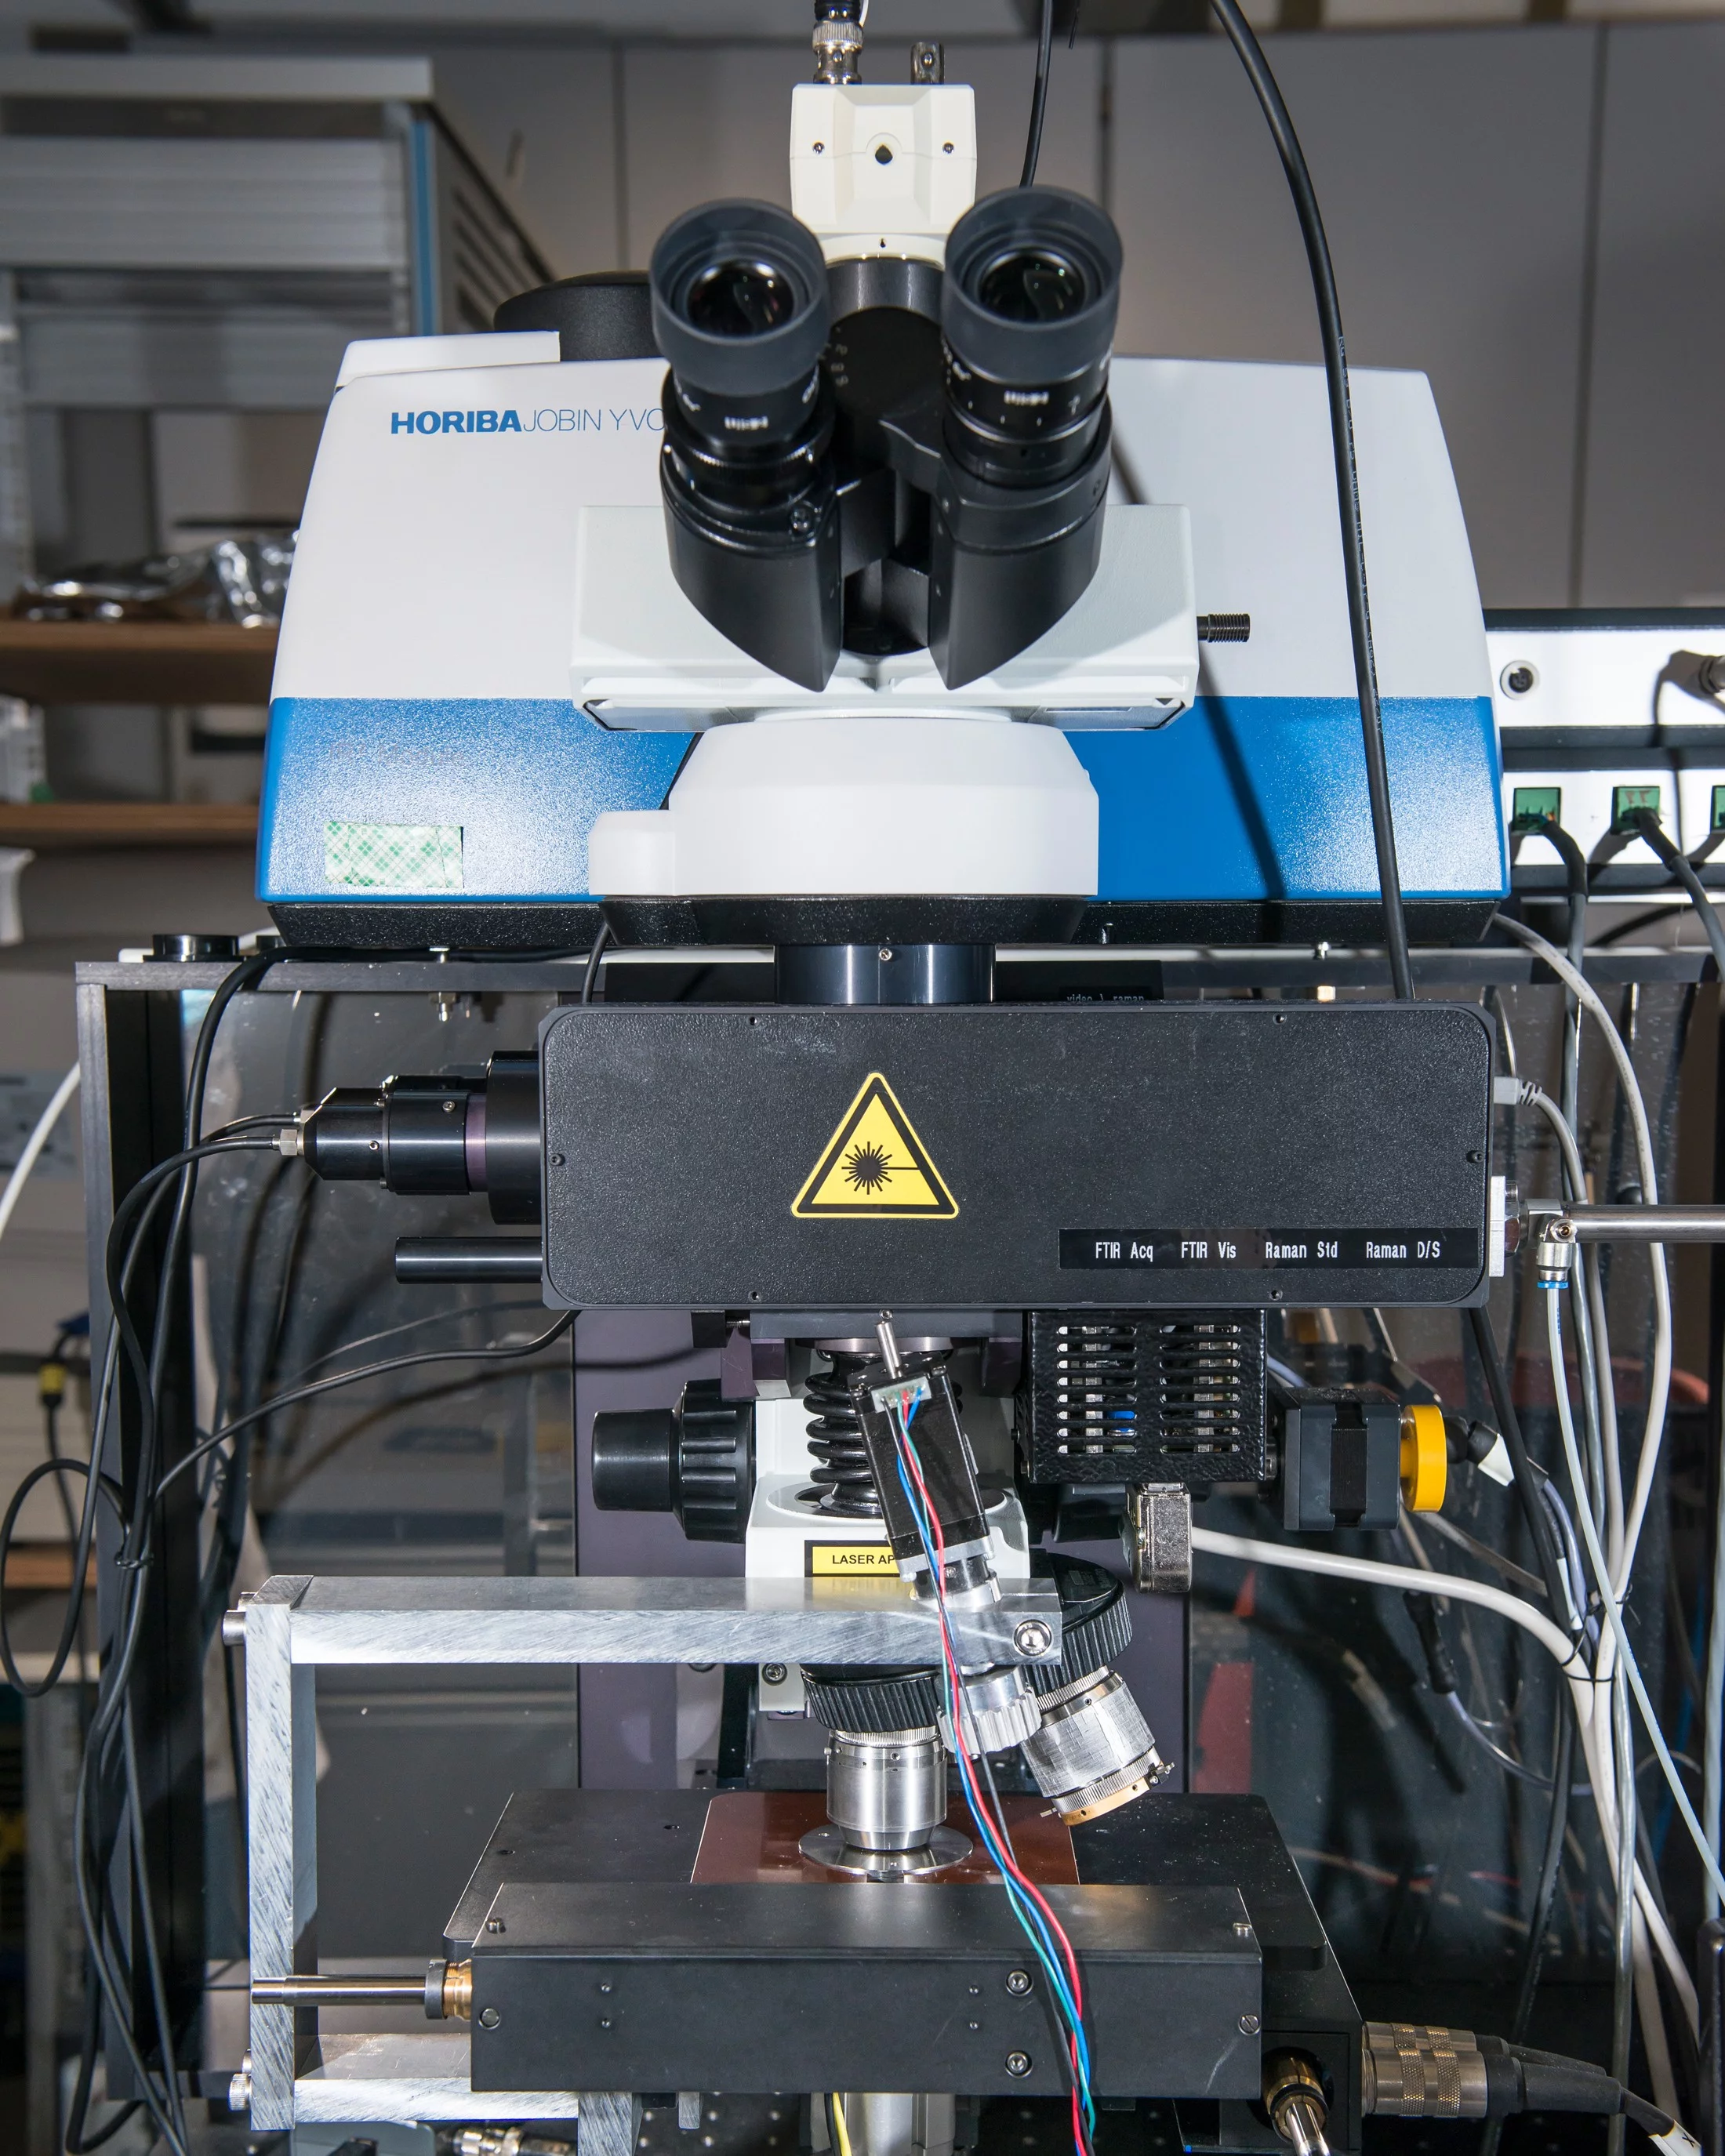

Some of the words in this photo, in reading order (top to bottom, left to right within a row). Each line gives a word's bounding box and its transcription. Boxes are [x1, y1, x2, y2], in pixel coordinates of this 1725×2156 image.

[391, 409, 522, 434] HORIBA
[523, 408, 601, 432] JOBIN
[1095, 1242, 1120, 1259] FTIR
[1130, 1241, 1153, 1261] Acq
[1181, 1242, 1208, 1258] FTIR
[1218, 1242, 1237, 1258] Vis
[1265, 1243, 1307, 1258] Raman
[1317, 1241, 1338, 1258] Std
[1366, 1242, 1407, 1258] Raman
[1417, 1242, 1440, 1258] D/S
[832, 1555, 874, 1565] LASER
